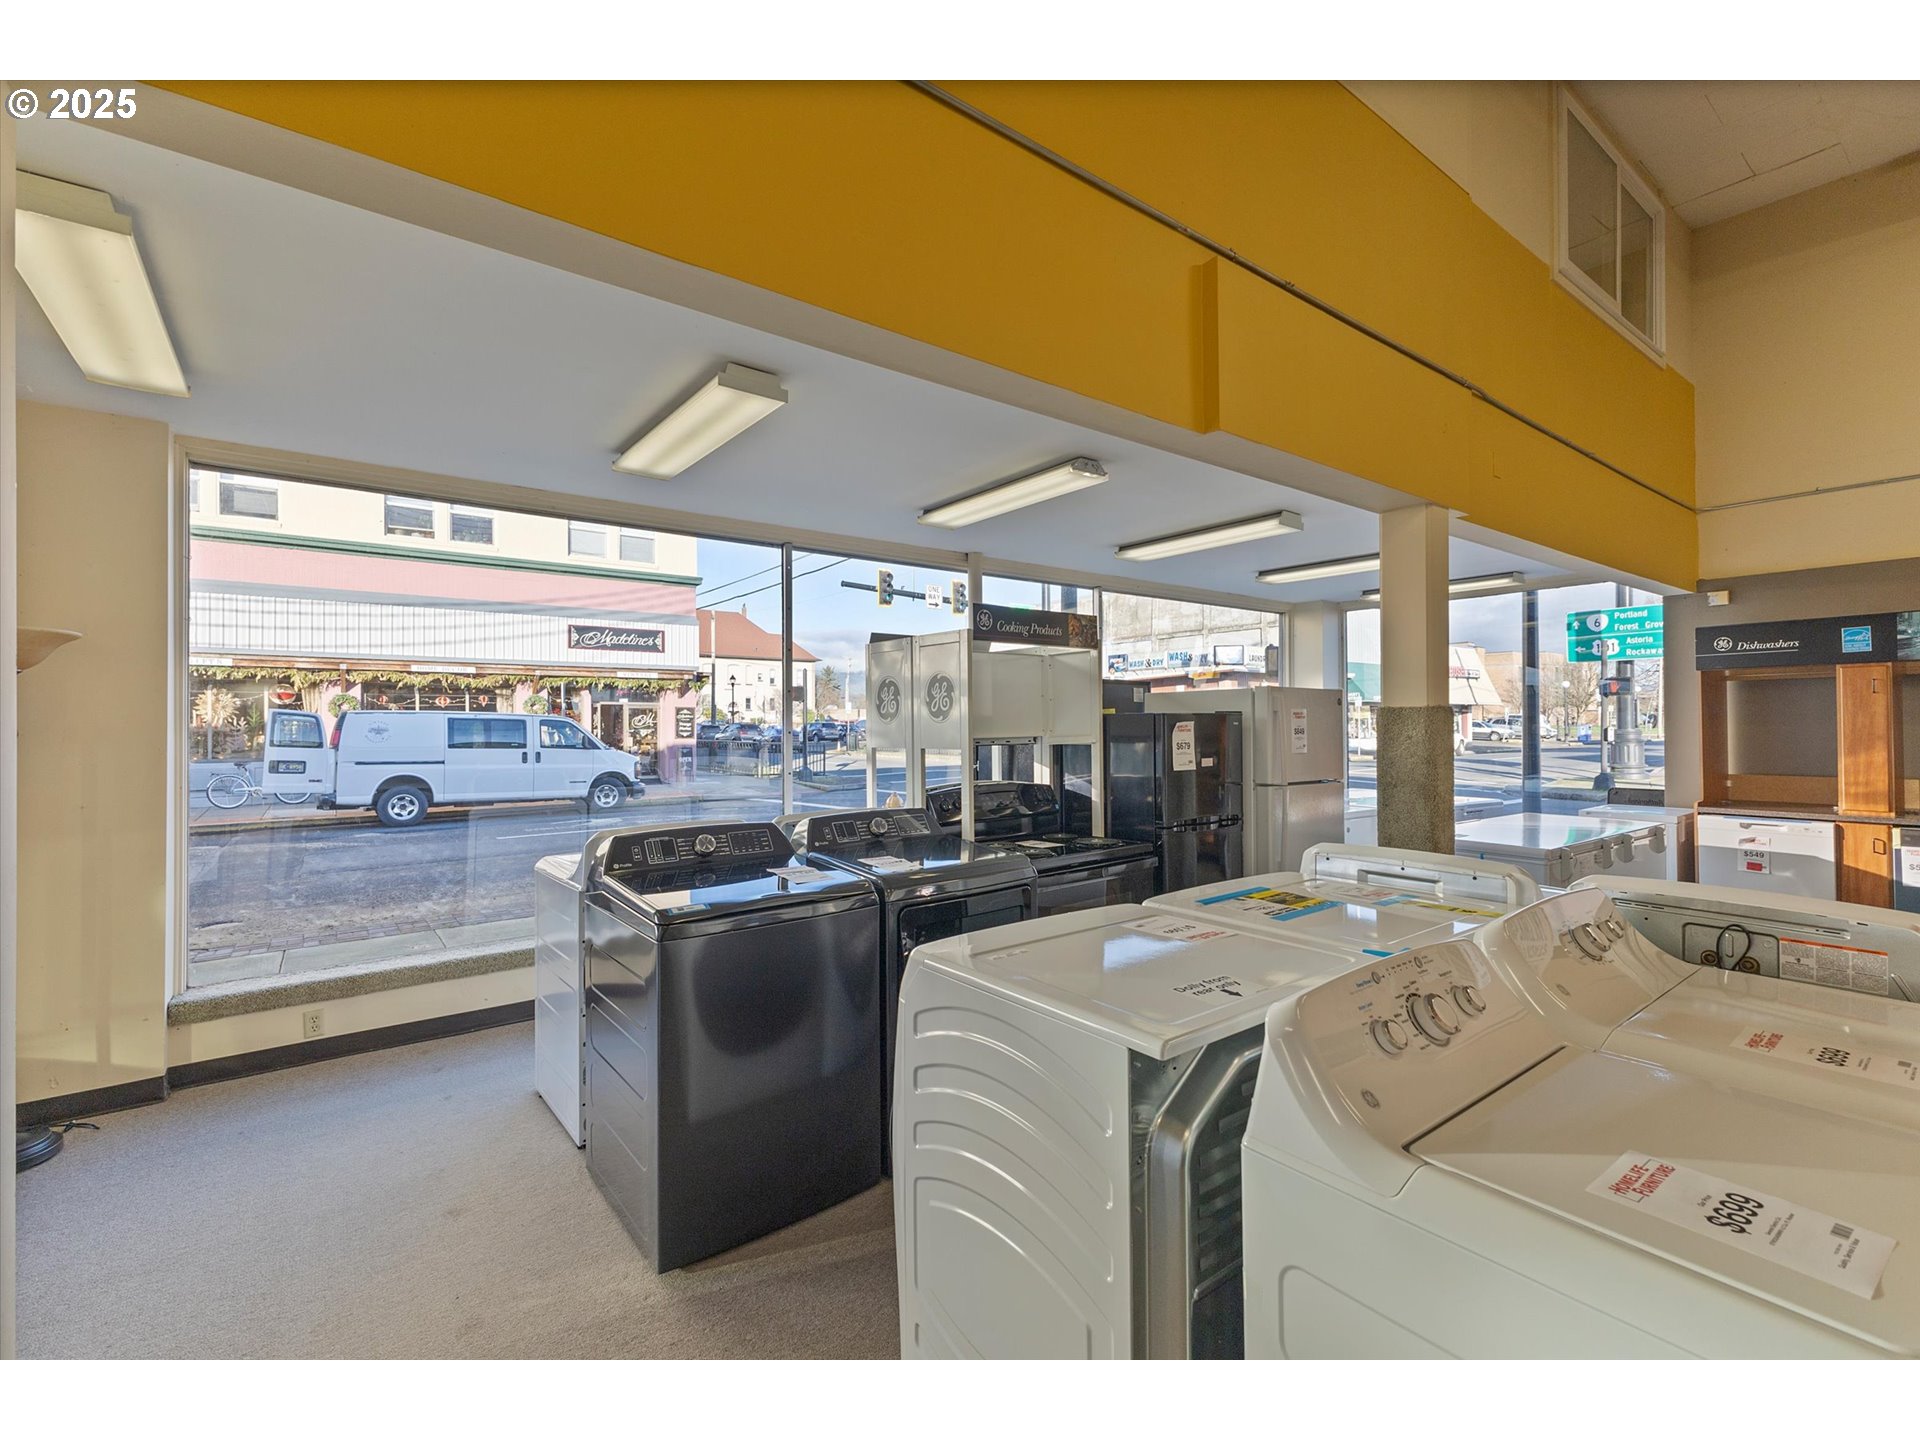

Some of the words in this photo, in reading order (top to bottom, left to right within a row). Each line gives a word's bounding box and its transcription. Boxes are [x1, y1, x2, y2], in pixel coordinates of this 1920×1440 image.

[928, 585, 940, 593] ONE
[1614, 609, 1648, 619] Portland
[1594, 618, 1600, 627] 6
[1614, 622, 1639, 631] Forest
[1645, 620, 1663, 629] Grov
[997, 620, 1029, 637] Cooking
[1030, 623, 1063, 637] Products
[1626, 636, 1654, 644] Astoria
[1737, 639, 1800, 651] Dishwashers
[1596, 642, 1615, 653] 11
[1626, 647, 1663, 656] Rockawa
[1168, 651, 1188, 661] WASH
[1129, 660, 1144, 668] WASH
[1144, 658, 1152, 668] &
[1152, 658, 1165, 667] DRY
[1294, 727, 1305, 736] $849
[1176, 742, 1191, 751] $679
[1743, 850, 1765, 859] $549
[1909, 863, 1920, 871] $5
[1172, 979, 1206, 993] Dolly
[1202, 974, 1232, 986] from
[1192, 986, 1214, 997] rear
[1215, 979, 1242, 990] only
[1608, 1164, 1650, 1195] HOMELIFE
[1631, 1163, 1677, 1197] FURNITURE
[1704, 1192, 1765, 1236] $699
